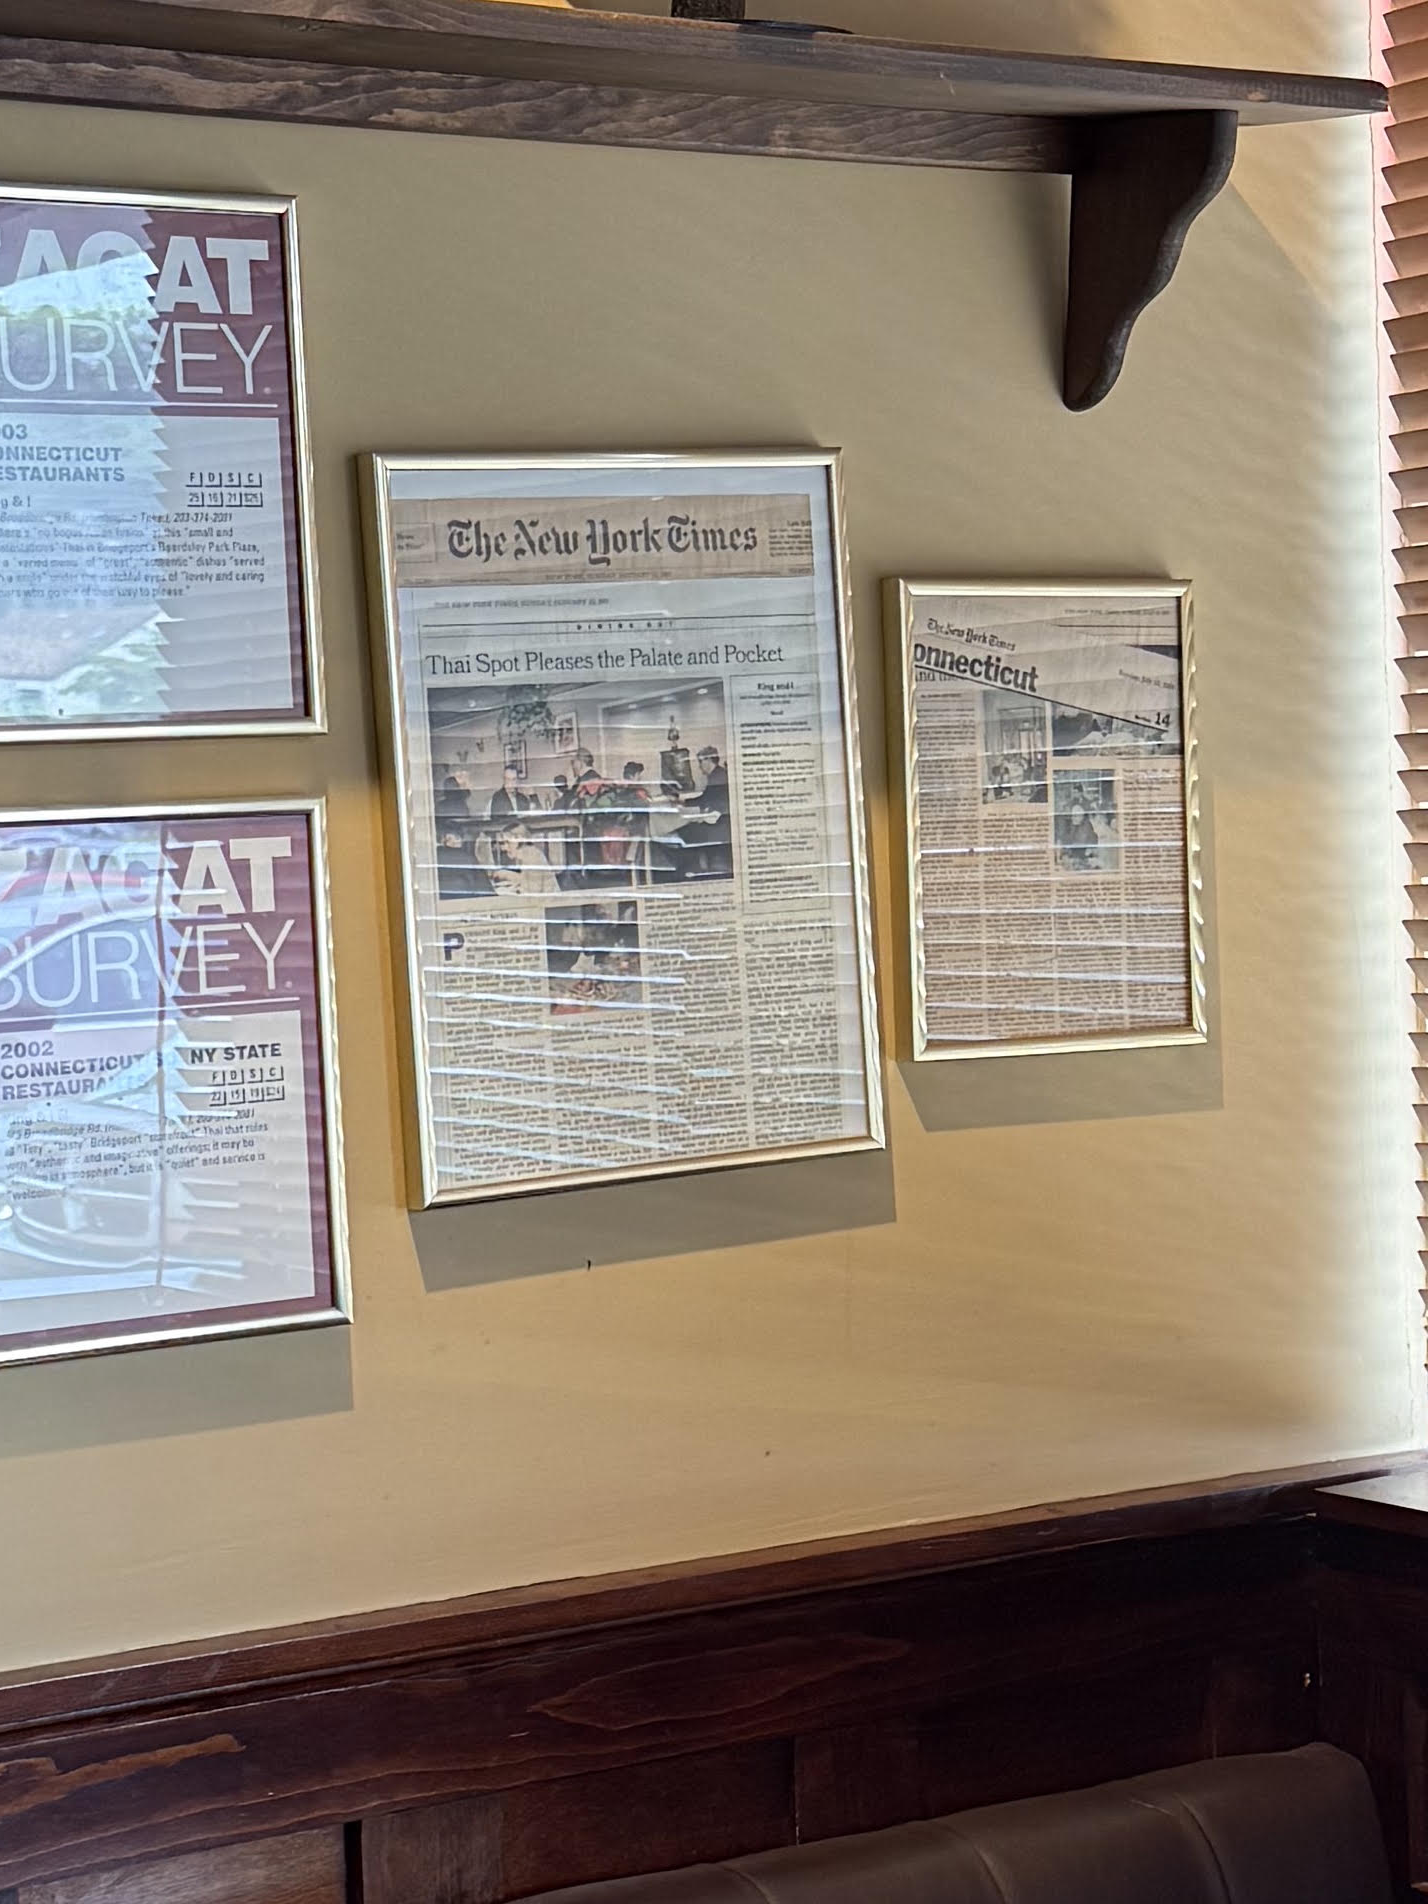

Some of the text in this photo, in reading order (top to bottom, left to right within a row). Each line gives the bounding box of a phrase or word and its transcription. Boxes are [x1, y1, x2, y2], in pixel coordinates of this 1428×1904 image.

[190, 472, 254, 483] F D S C
[12, 495, 23, 507] &
[447, 519, 507, 562] The
[514, 519, 578, 561] New
[586, 516, 662, 566] York
[667, 514, 758, 553] Times
[425, 644, 784, 677] Thai Spot Pleases the Palate and Pocket
[1155, 712, 1171, 727] 14
[0, 1040, 54, 1060] 2002
[191, 1047, 217, 1064] NY
[223, 1043, 282, 1061] STATE
[269, 1067, 276, 1077] C
[203, 1125, 223, 1136] Thai
[224, 1123, 244, 1134] that
[202, 1155, 220, 1166] and
